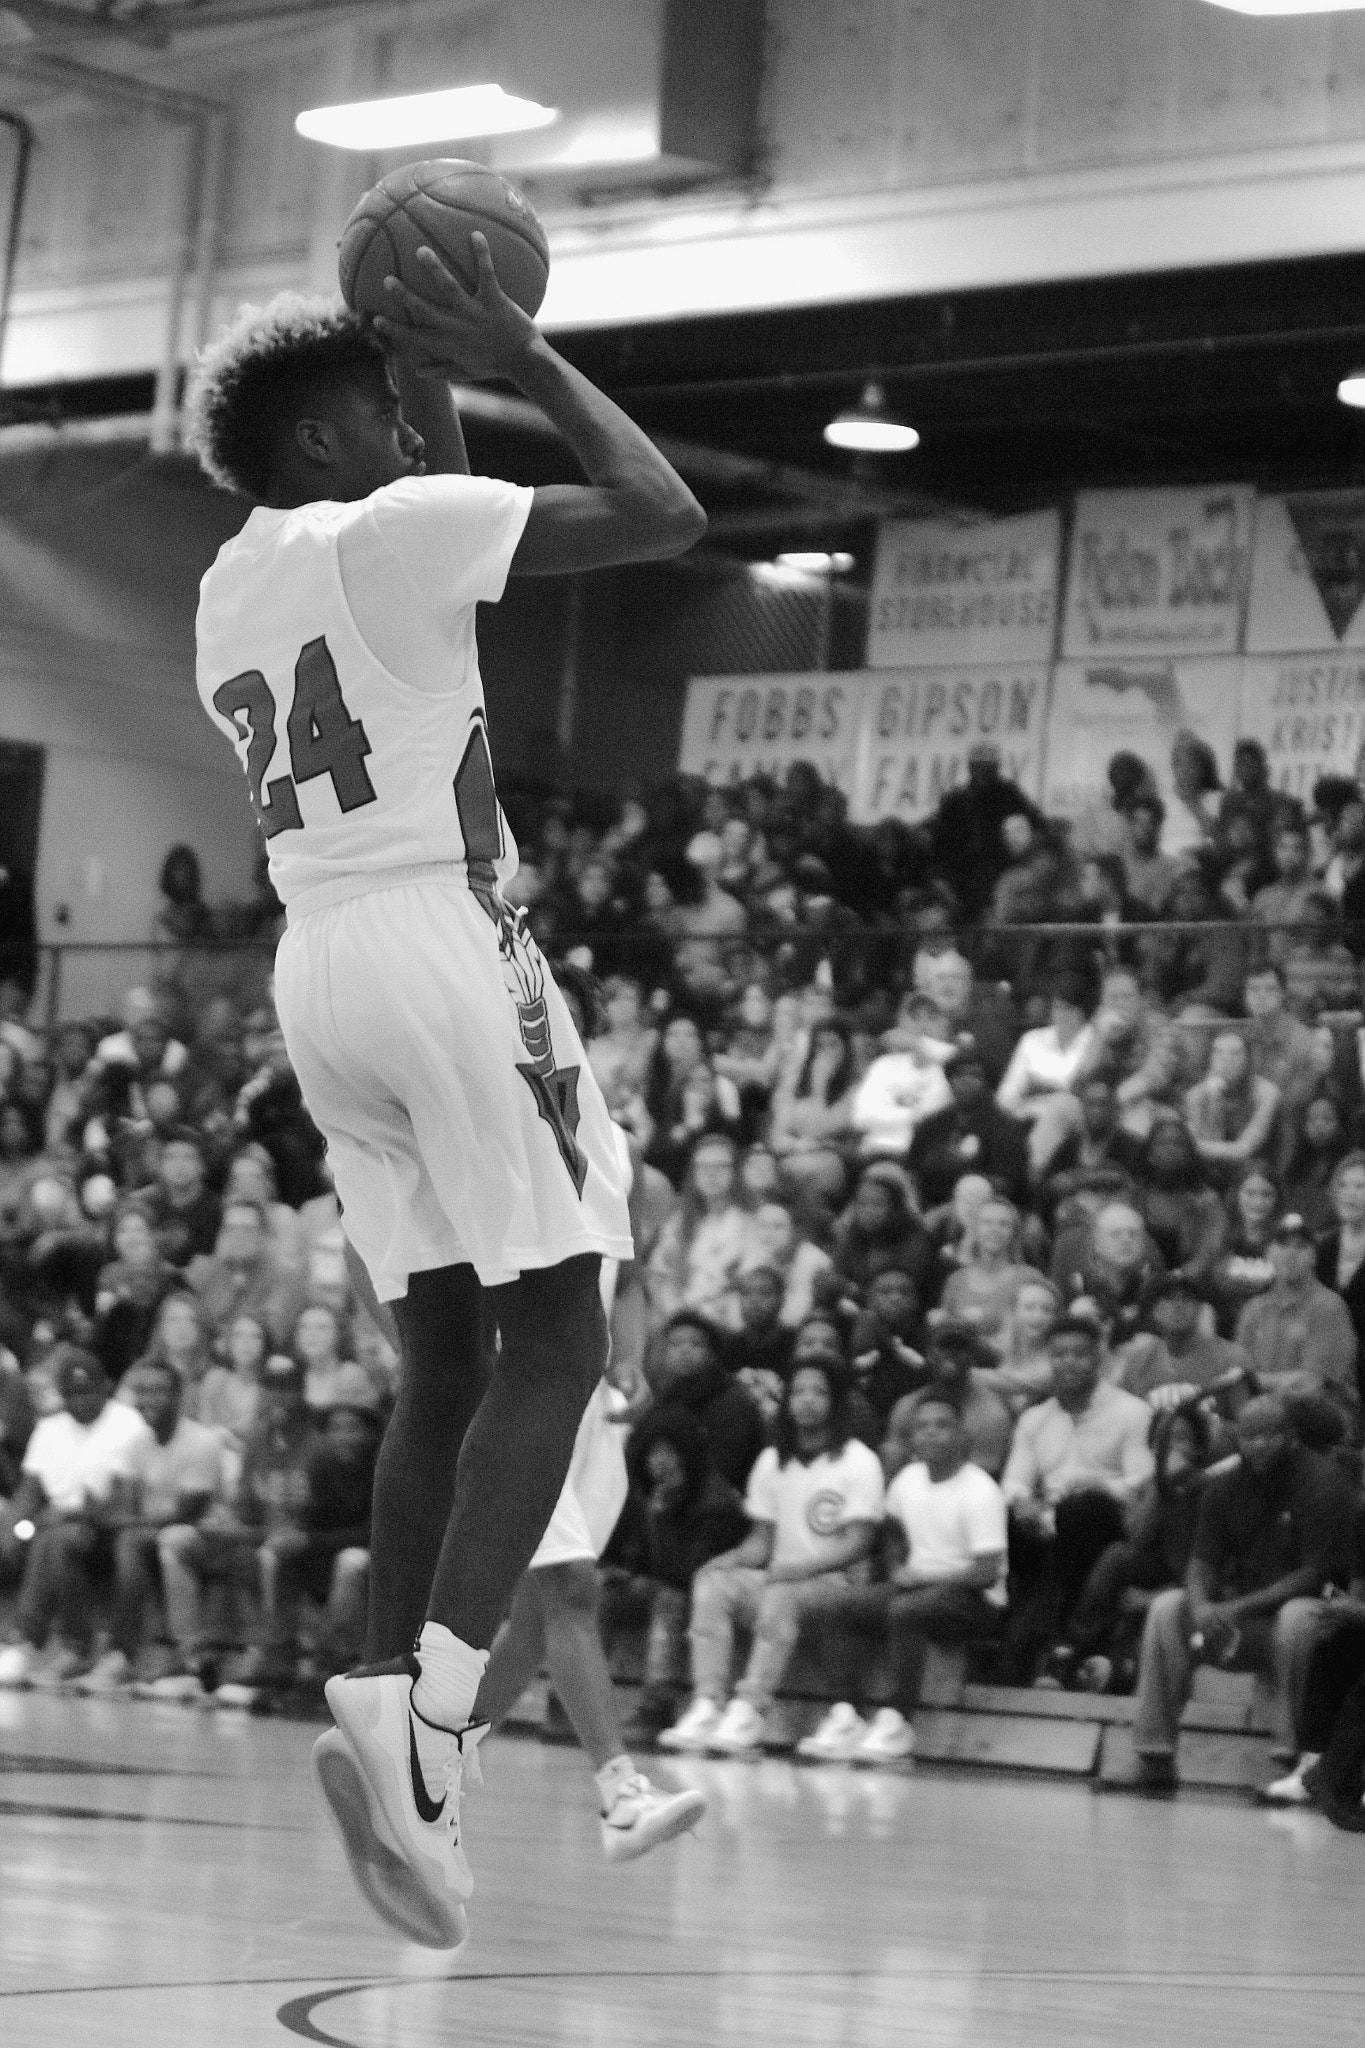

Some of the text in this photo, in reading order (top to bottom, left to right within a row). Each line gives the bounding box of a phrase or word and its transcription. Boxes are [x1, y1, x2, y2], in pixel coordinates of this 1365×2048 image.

[212, 634, 378, 840] 24
[709, 686, 844, 743] FOBBS
[877, 679, 1038, 738] GIPSON
